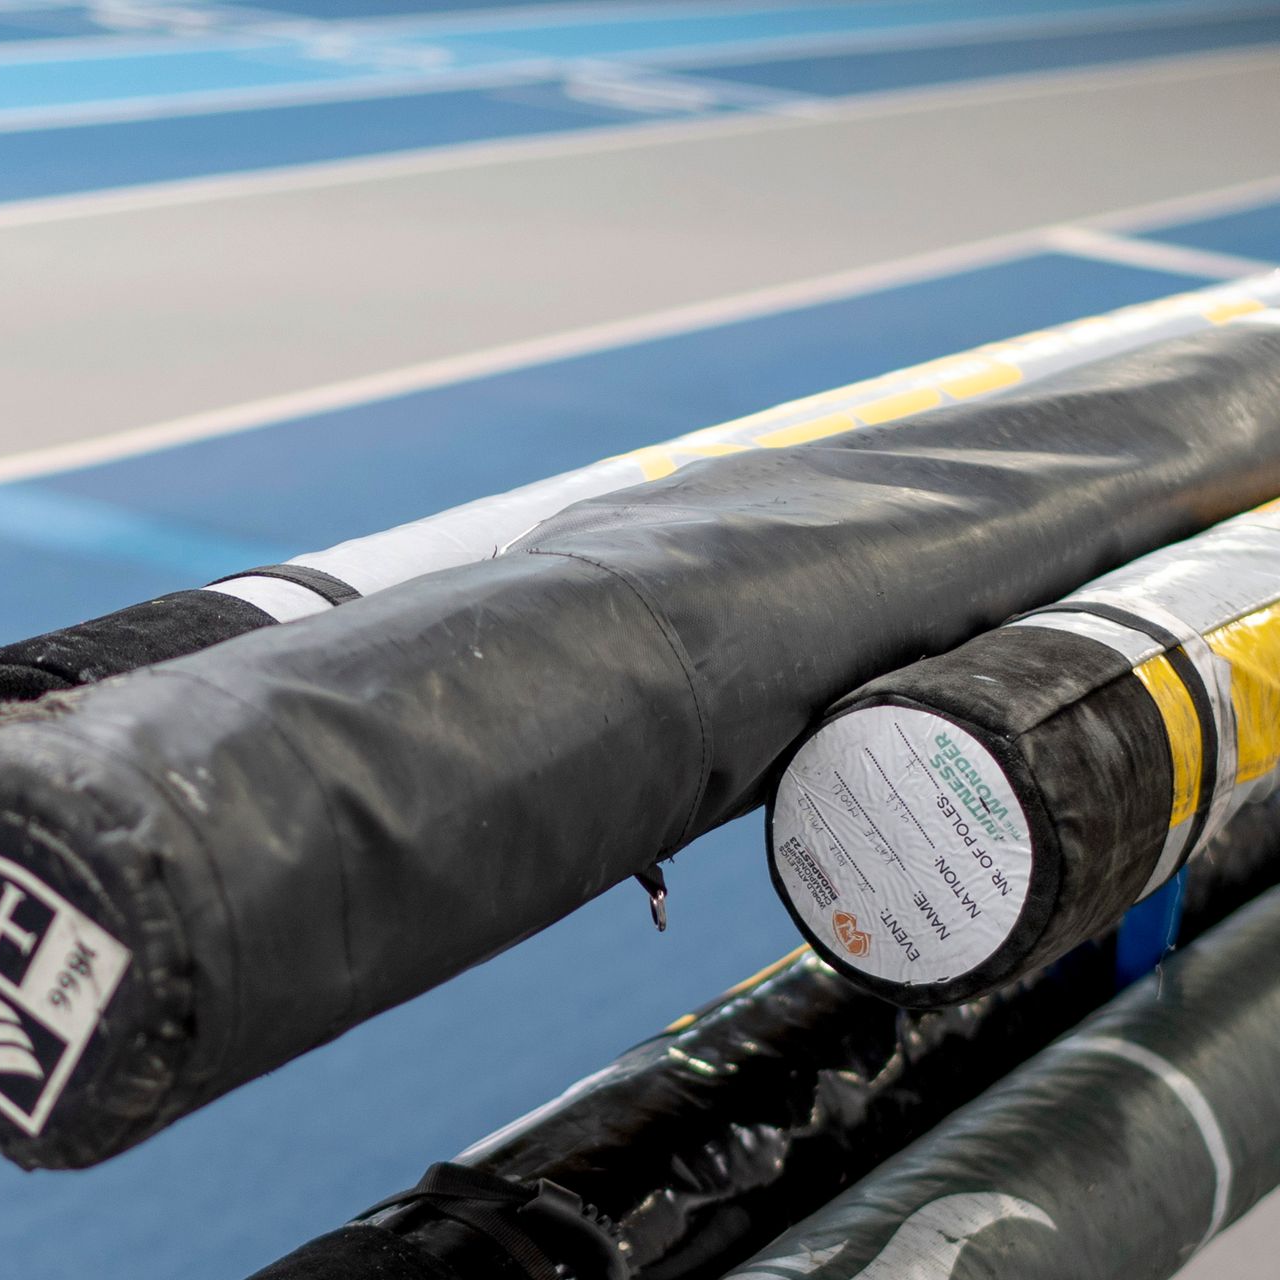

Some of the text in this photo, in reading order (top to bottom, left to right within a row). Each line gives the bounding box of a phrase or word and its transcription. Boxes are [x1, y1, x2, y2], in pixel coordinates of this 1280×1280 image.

[929, 753, 1004, 844] WITNESS
[934, 732, 1022, 841] THE WONDER
[783, 841, 832, 906] CHAMPIONSHIPS
[789, 837, 838, 901] BUDAPEST 23
[933, 791, 1013, 896] NR. OF POLES:
[778, 845, 827, 910] WORLD ATHLETICS
[932, 855, 981, 919] NATION:
[878, 907, 920, 962] EVENT:
[911, 889, 951, 941] NAME:
[47, 939, 96, 1012] 1866
